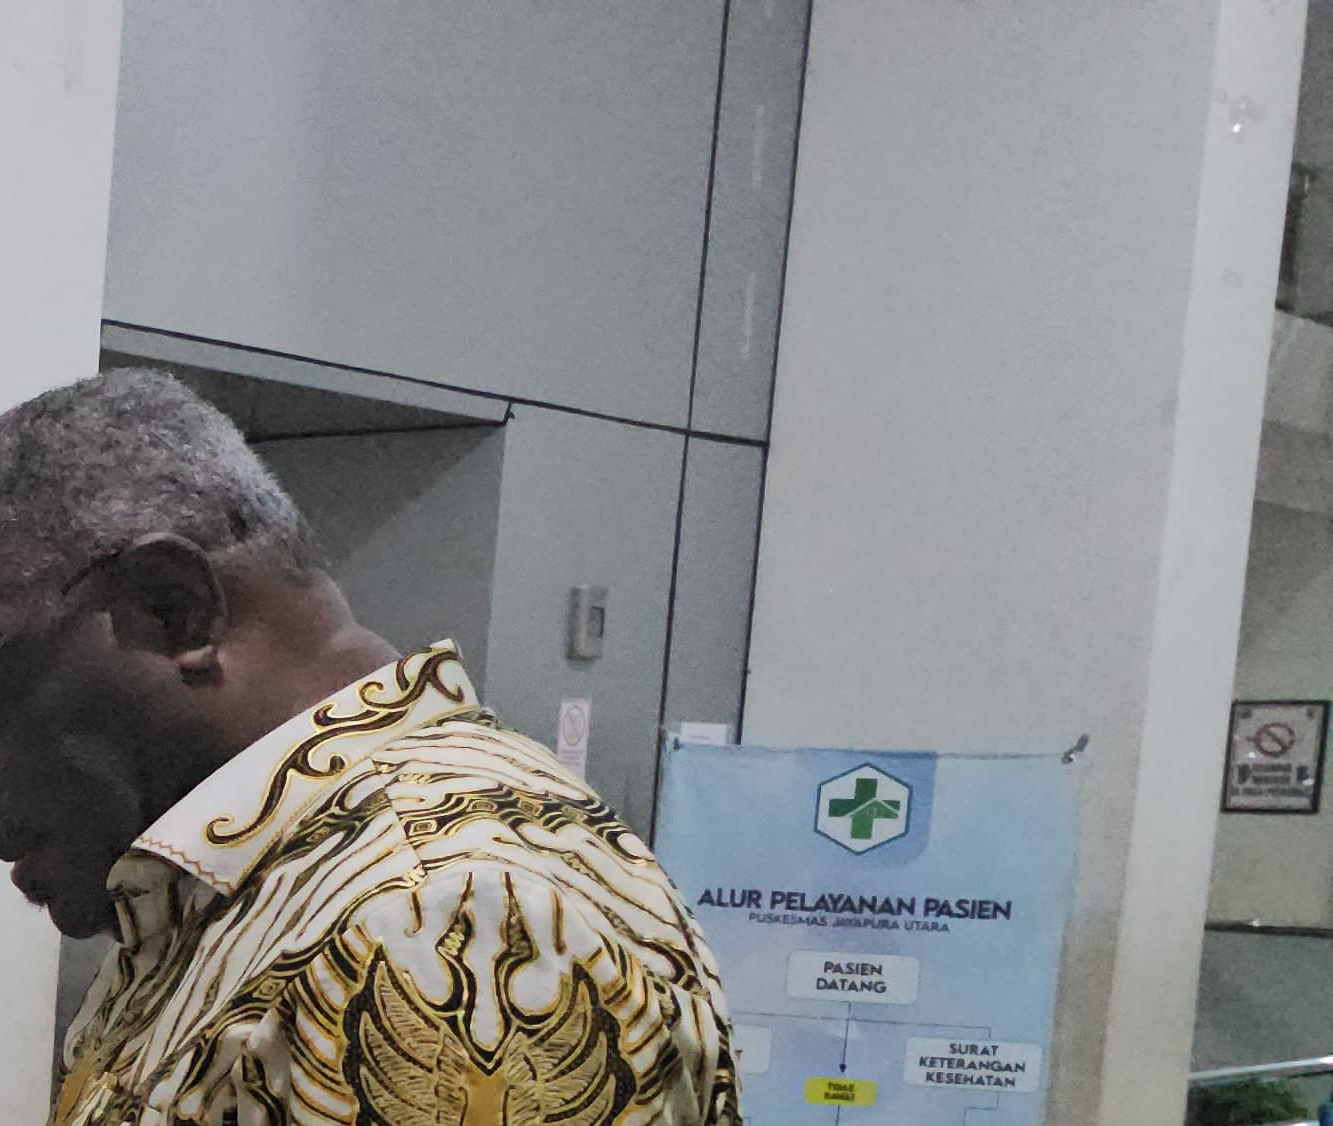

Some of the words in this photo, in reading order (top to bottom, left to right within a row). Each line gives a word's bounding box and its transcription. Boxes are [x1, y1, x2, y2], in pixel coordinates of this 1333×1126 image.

[698, 888, 762, 910] ALUR
[770, 891, 917, 916] PELAYANAN
[923, 898, 1012, 920] PASIEN
[748, 912, 828, 928] PUSKESMAS
[833, 916, 899, 931] JAYAPURA
[904, 919, 950, 933] UTARA
[823, 960, 883, 977] PASIEN
[815, 977, 887, 995] DATANG
[948, 1043, 999, 1058] SURAT
[918, 1056, 1027, 1073] KETERANGAN
[925, 1071, 1017, 1088] KESEHATAN
